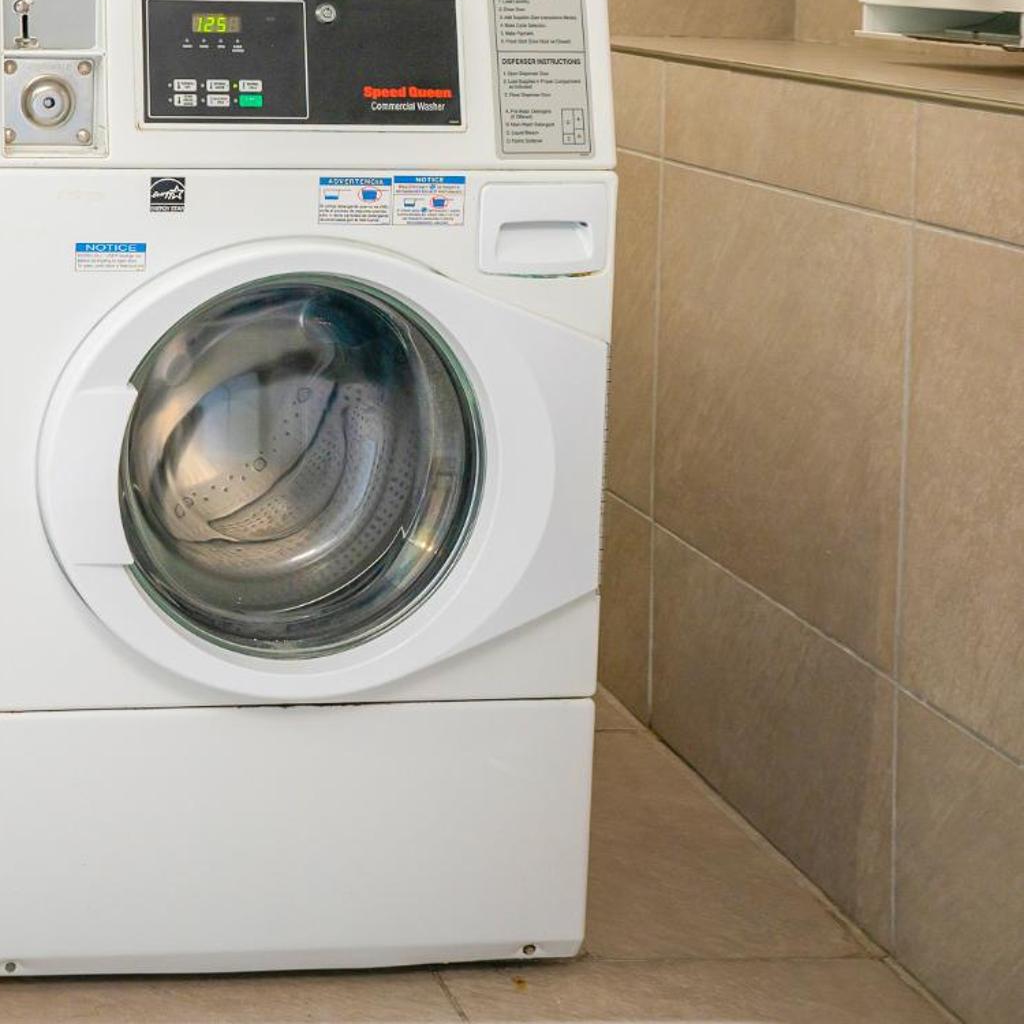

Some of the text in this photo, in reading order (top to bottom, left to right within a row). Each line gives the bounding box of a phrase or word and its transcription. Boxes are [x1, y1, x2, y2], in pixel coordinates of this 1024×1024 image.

[198, 16, 227, 33] 125
[362, 85, 453, 99] Speed Queen
[370, 101, 446, 111] Commercial Washer
[85, 243, 137, 252] NOTICE
